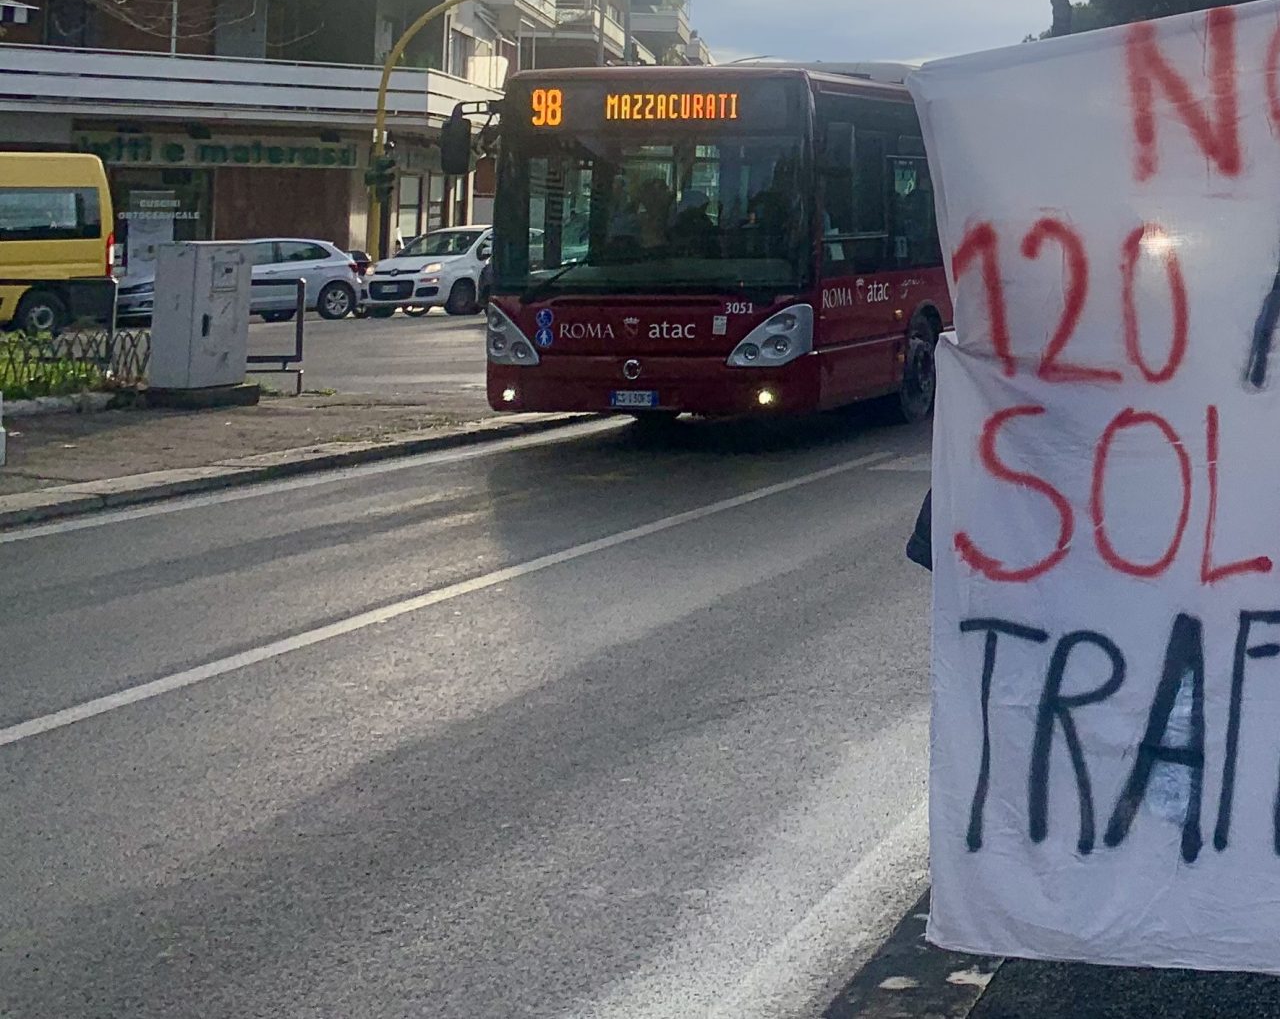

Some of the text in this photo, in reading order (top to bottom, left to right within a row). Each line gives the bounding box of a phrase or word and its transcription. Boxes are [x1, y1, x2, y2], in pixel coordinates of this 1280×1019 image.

[531, 88, 737, 126] 98 MAZZACURATI
[725, 302, 753, 314] 3051
[822, 287, 852, 309] ROMA
[867, 281, 889, 302] atac
[952, 216, 1190, 384] 120
[559, 320, 696, 339] ROMA atac
